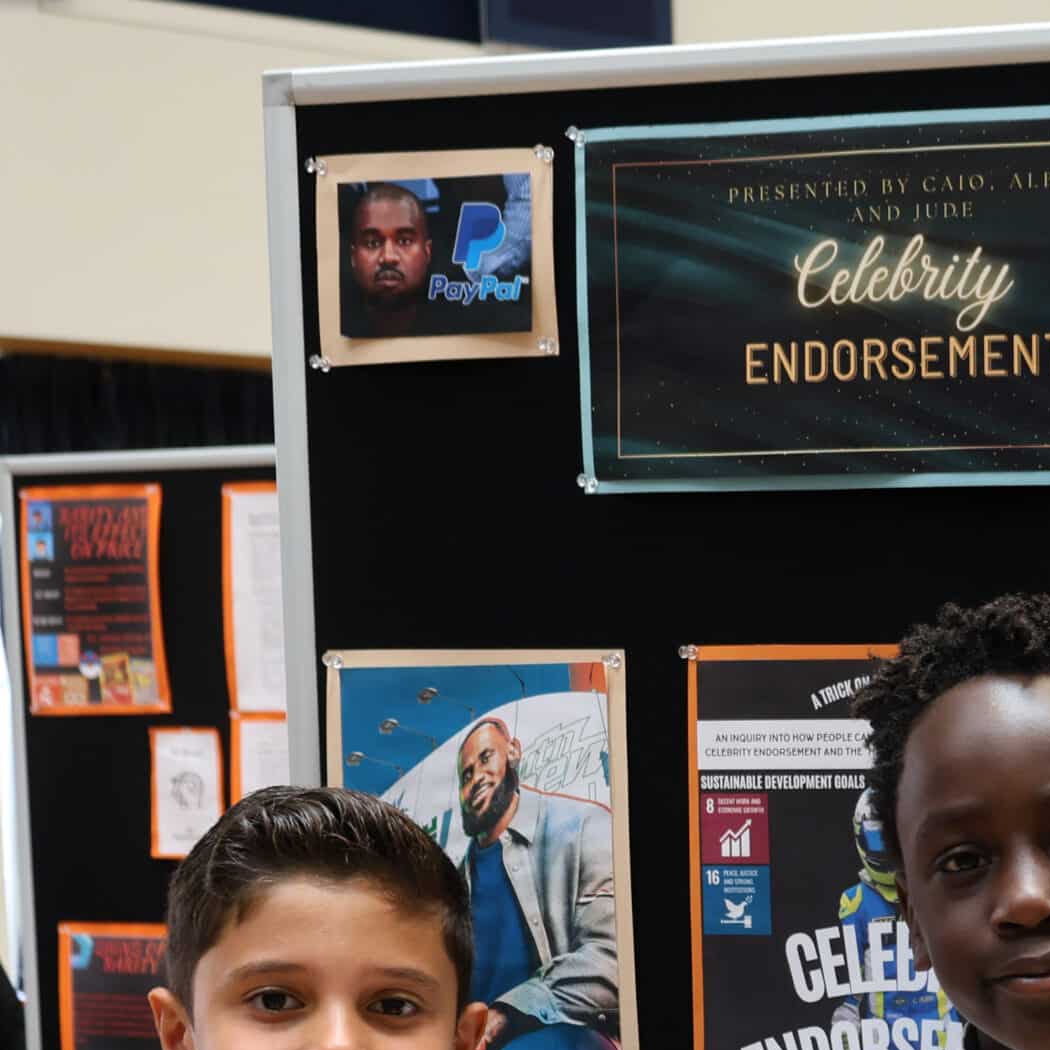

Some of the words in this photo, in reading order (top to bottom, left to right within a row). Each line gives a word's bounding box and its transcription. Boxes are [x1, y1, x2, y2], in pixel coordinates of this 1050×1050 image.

[728, 180, 867, 203] PRESENTED
[882, 178, 907, 195] BY
[850, 202, 903, 223] AND
[912, 201, 975, 222] JUDE
[794, 235, 1016, 333] Celebrity
[810, 693, 822, 710] A
[820, 681, 854, 704] TRICK
[716, 734, 728, 742] AN
[730, 734, 767, 743] INQUIRY
[769, 733, 791, 742] INTO
[793, 733, 813, 742] HOW
[817, 733, 853, 742] PEOPLE
[705, 748, 752, 757] CELEBRITY
[754, 748, 823, 757] ENDORSEMENT
[824, 748, 844, 757] AND
[845, 748, 862, 756] THE
[701, 775, 764, 790] SUSTAINABLE
[765, 775, 832, 789] DEVELOPMENT
[834, 775, 865, 789] GOALS
[706, 798, 714, 814] 8
[706, 870, 720, 885] 16
[785, 922, 941, 1004] CELEB
